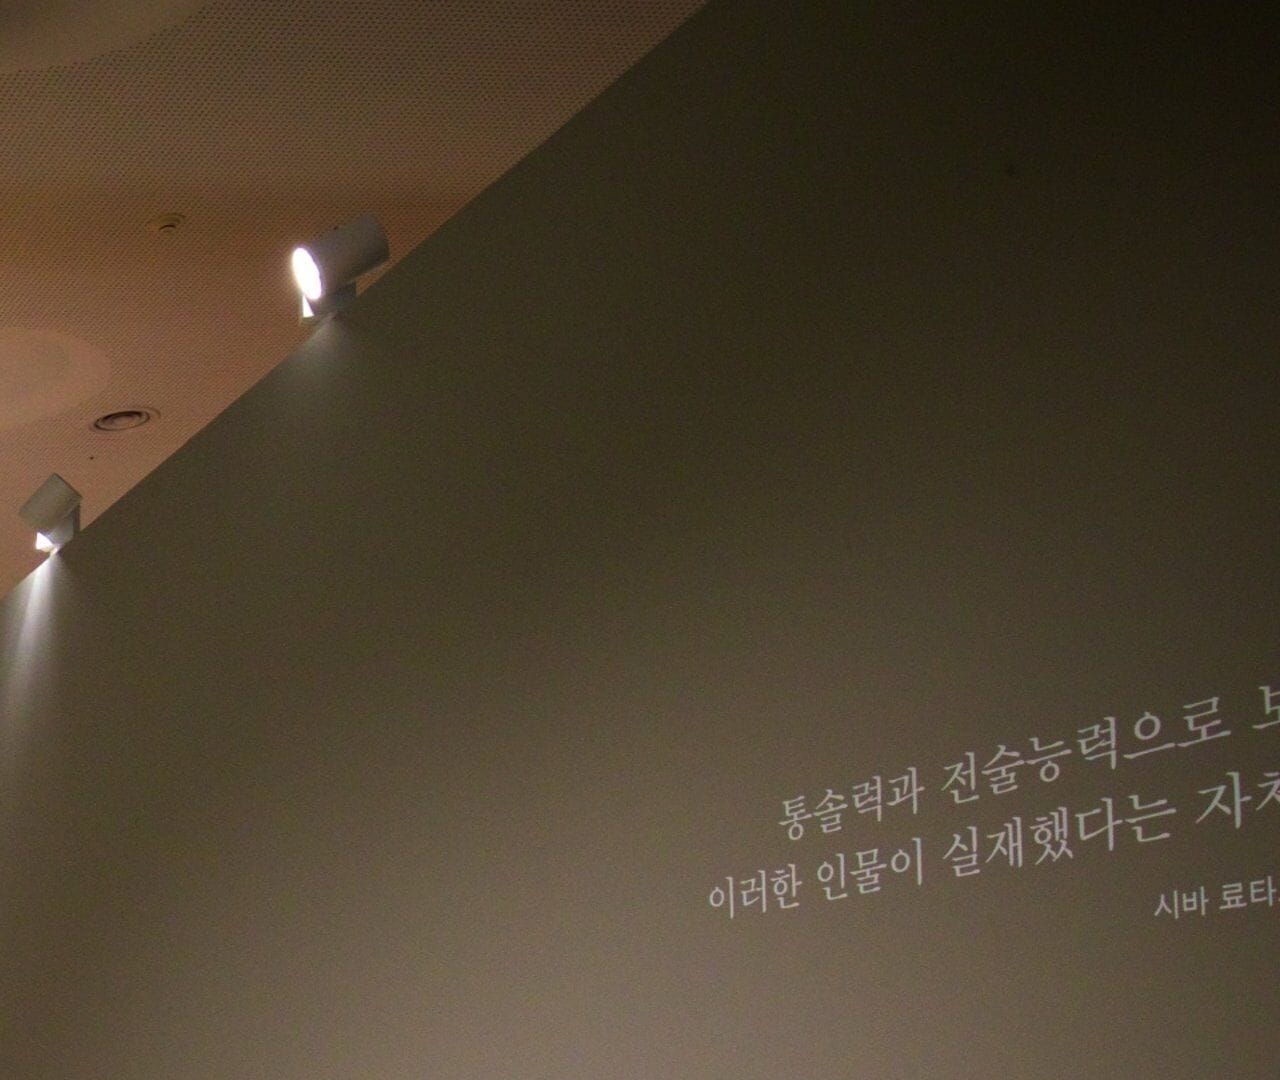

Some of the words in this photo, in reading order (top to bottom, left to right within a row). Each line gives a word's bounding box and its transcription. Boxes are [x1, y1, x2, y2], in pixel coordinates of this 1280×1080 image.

[779, 767, 925, 840] 통솔력과
[942, 697, 1231, 805] 전술능력으로
[709, 864, 802, 918] 이러한
[817, 837, 922, 900] 인물이
[943, 790, 1176, 877] 실재했다는
[1154, 886, 1208, 919] 시바
[1220, 876, 1276, 910] 료타
